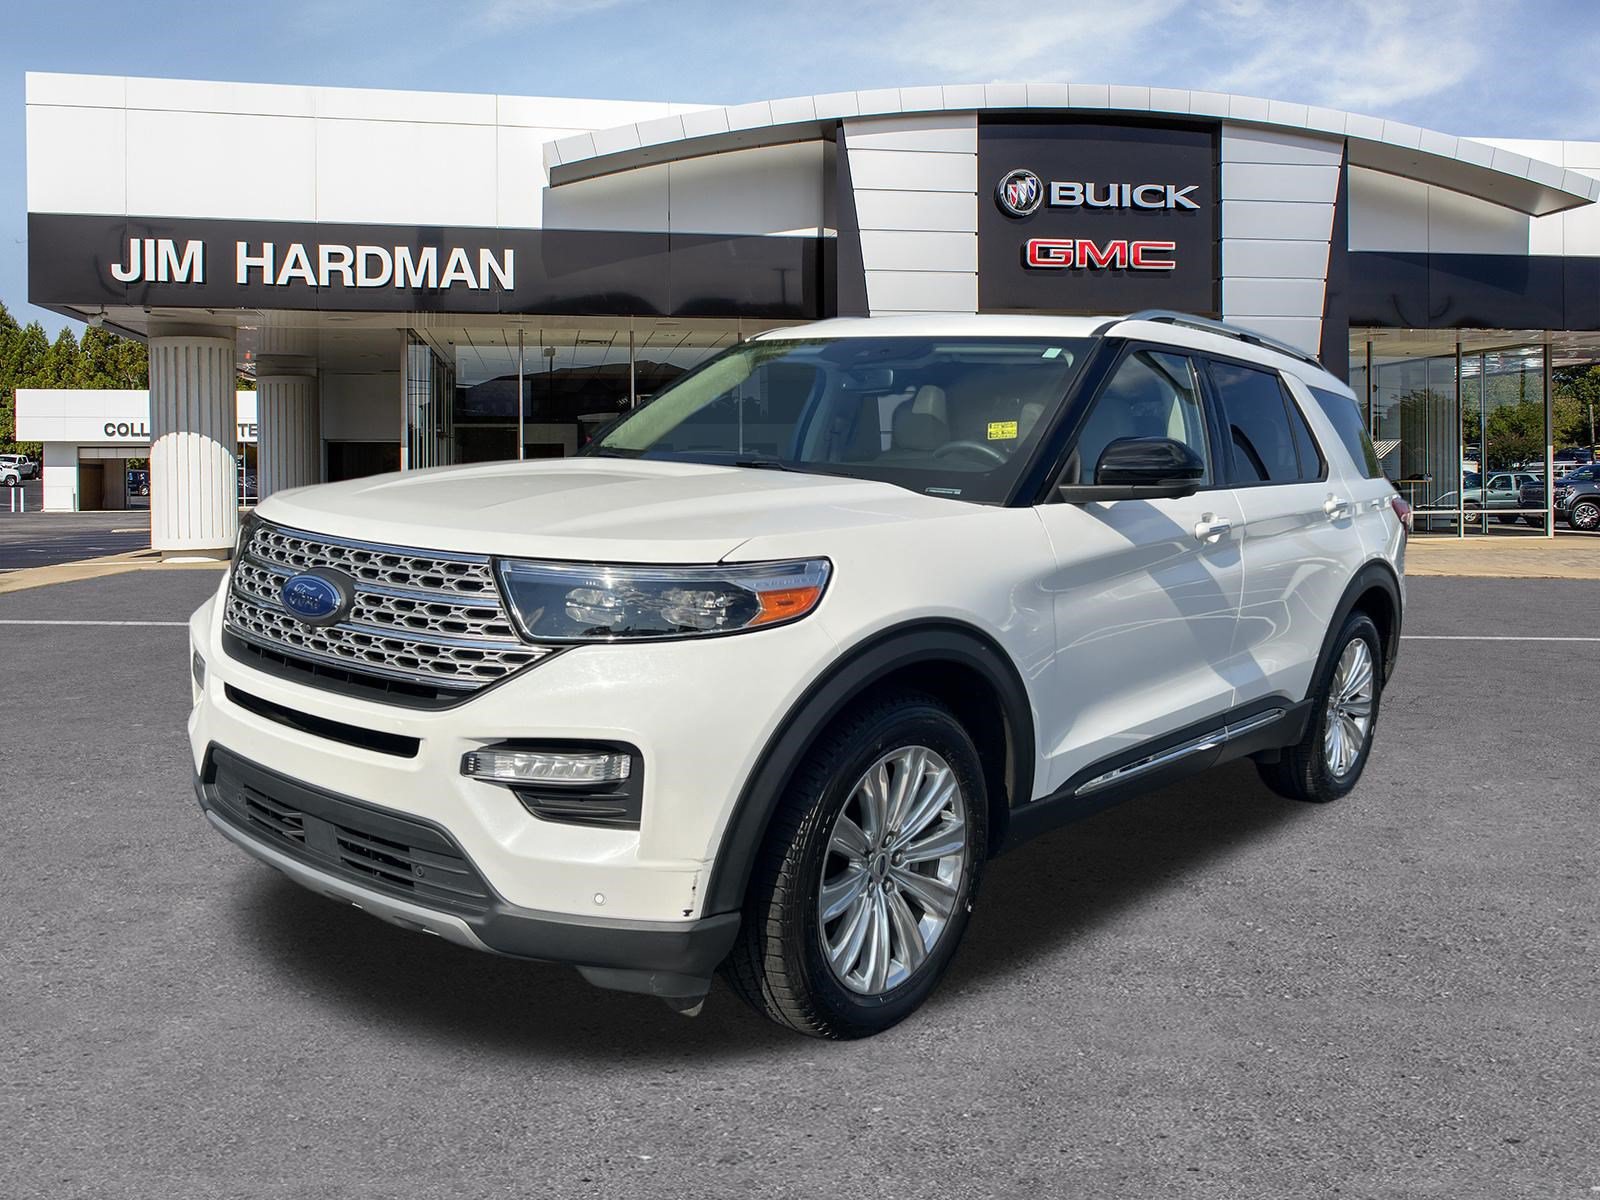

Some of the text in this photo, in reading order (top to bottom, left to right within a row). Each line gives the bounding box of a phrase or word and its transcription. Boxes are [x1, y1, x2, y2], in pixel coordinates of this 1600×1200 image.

[1050, 181, 1200, 210] BUICK
[111, 238, 515, 291] JIM HARDMAN
[1026, 238, 1176, 270] GMC
[289, 583, 323, 609] Ford
